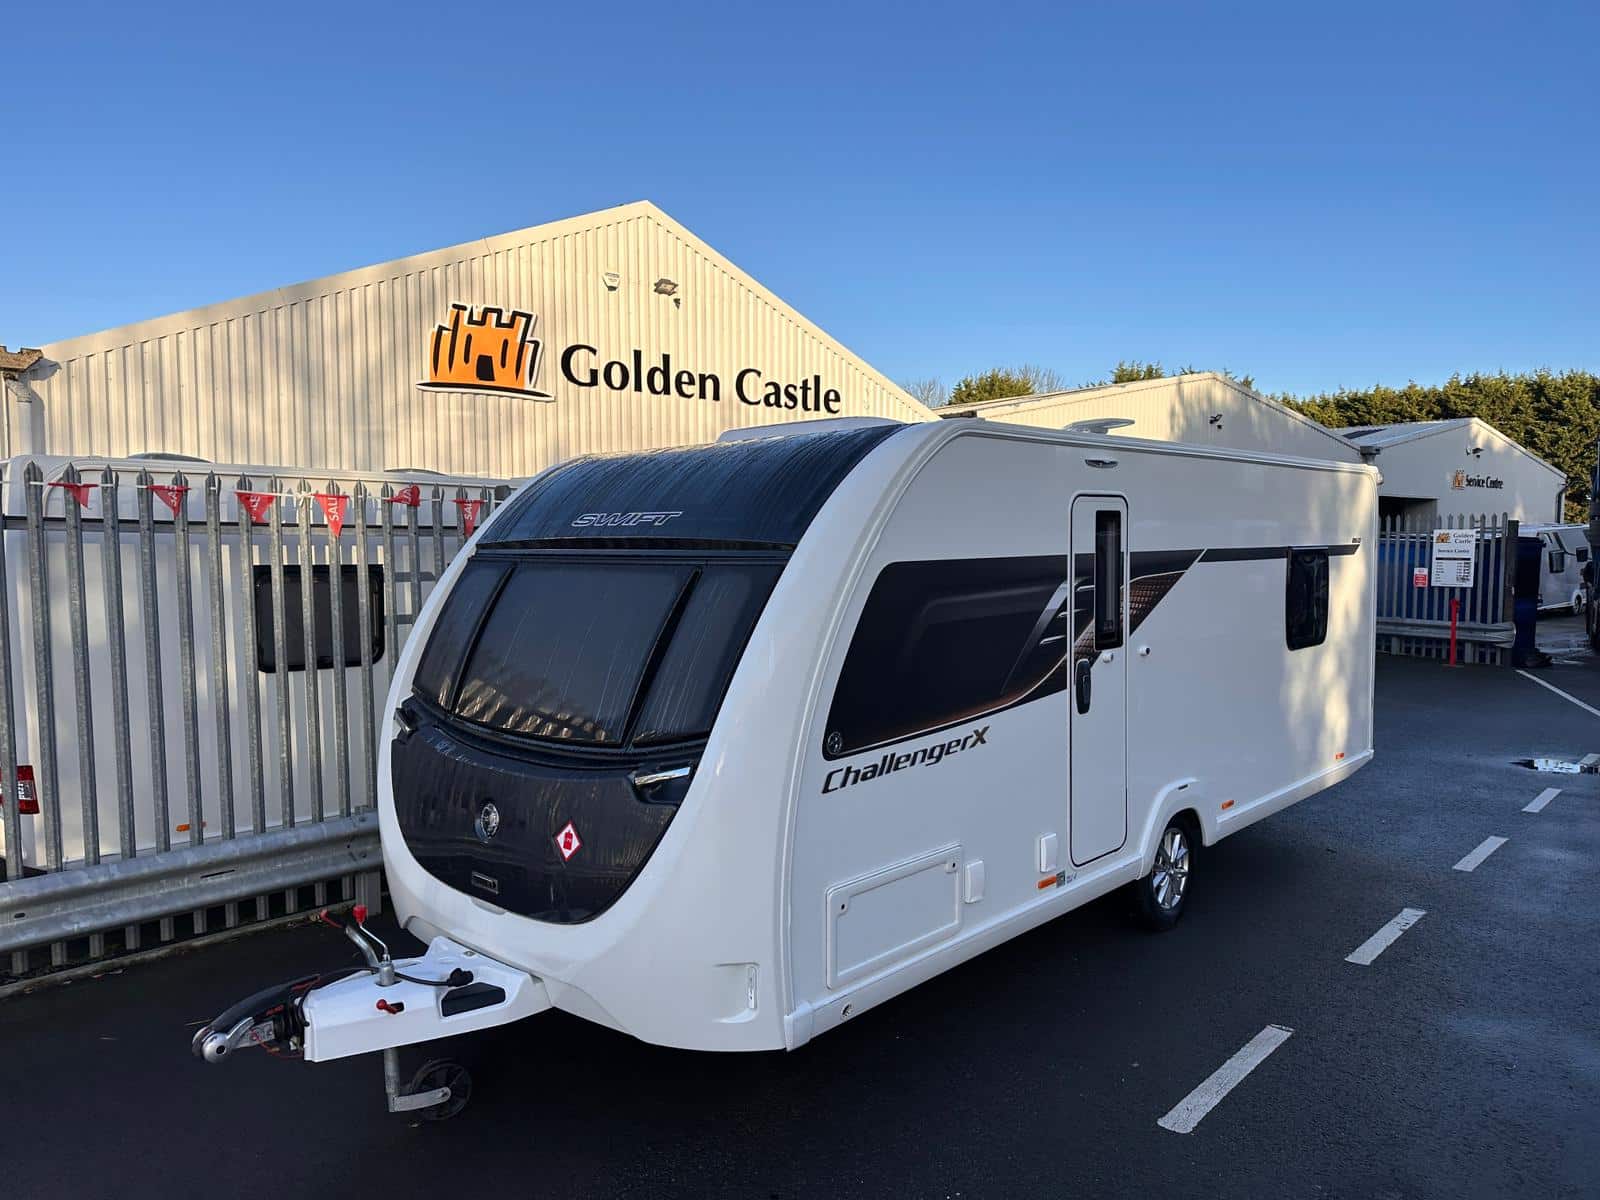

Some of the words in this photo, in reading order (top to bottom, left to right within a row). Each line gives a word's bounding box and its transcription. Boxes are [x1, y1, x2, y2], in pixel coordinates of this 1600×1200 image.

[560, 344, 720, 401] Golden
[735, 368, 841, 414] Castle
[1465, 474, 1485, 488] Service
[571, 511, 683, 527] SWIFT
